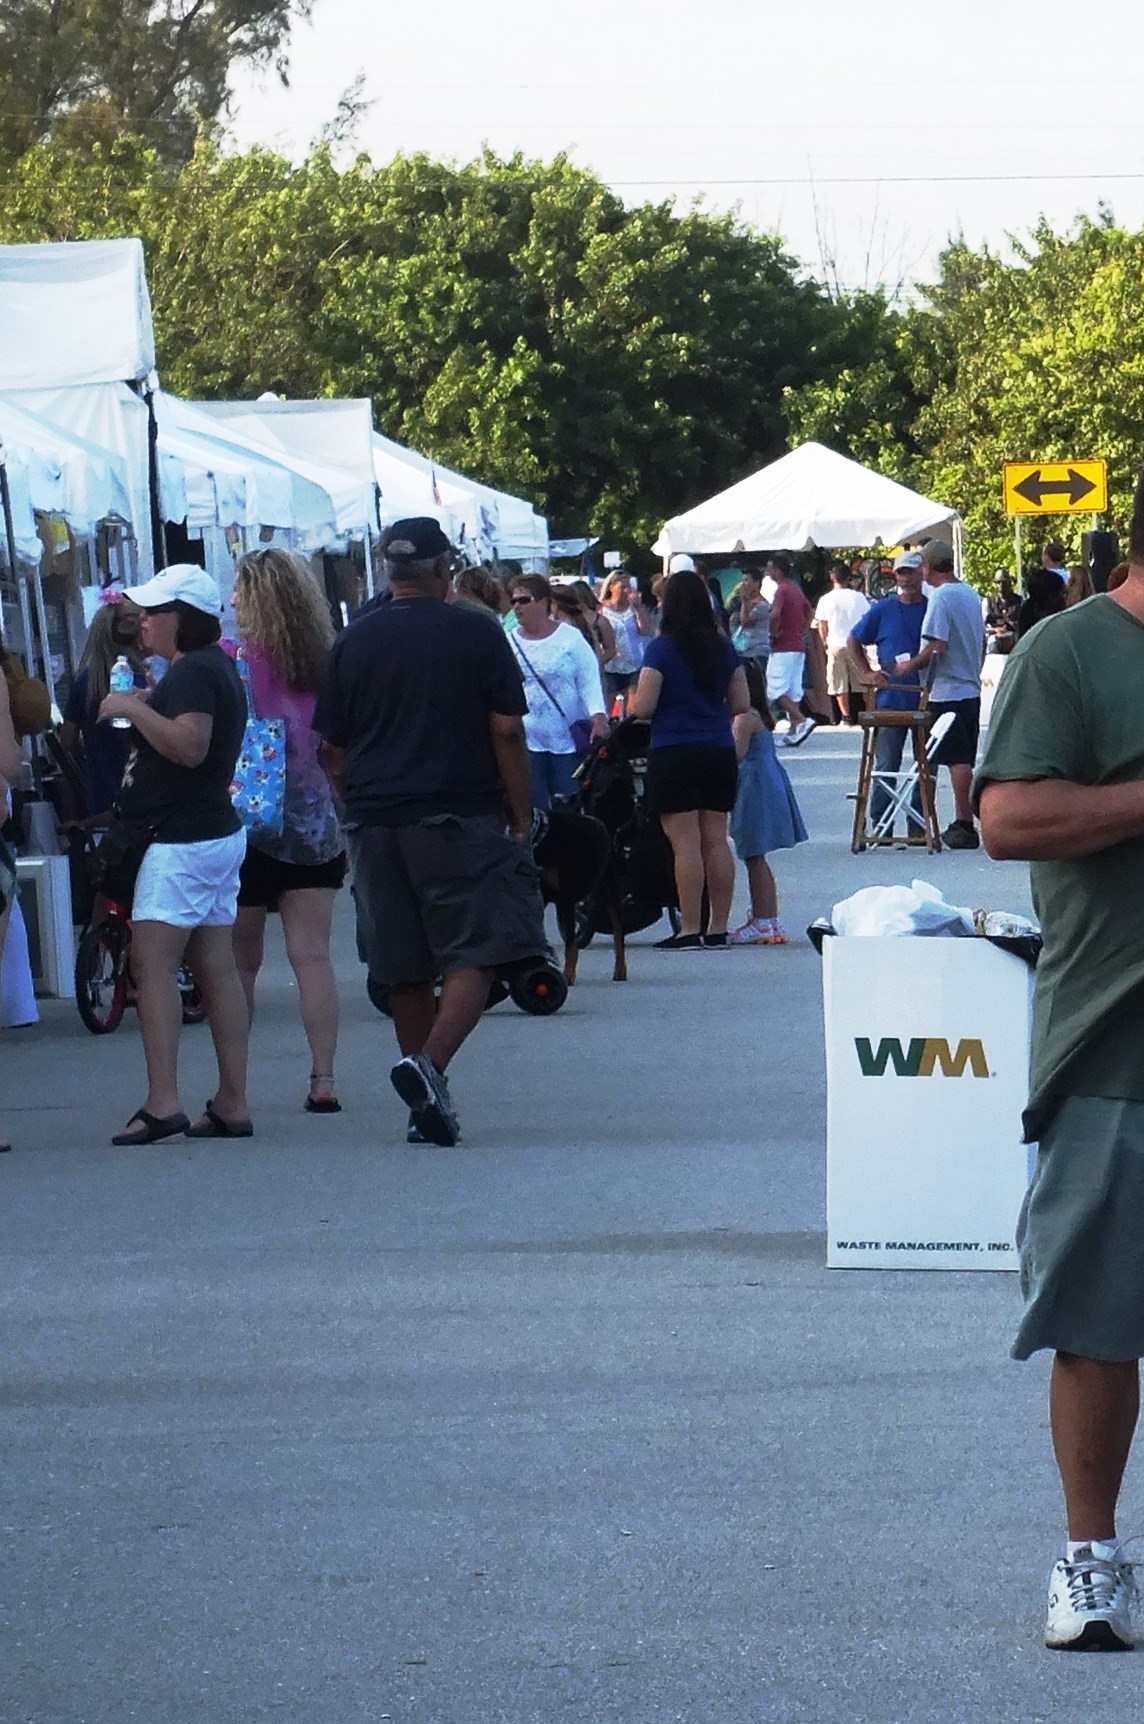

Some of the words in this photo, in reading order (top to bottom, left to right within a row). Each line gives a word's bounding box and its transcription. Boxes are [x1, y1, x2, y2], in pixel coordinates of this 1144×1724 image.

[854, 1037, 990, 1078] WM
[836, 1241, 881, 1250] WASTE
[886, 1241, 984, 1252] MANAGEMENT,
[987, 1243, 1014, 1252] INC.
